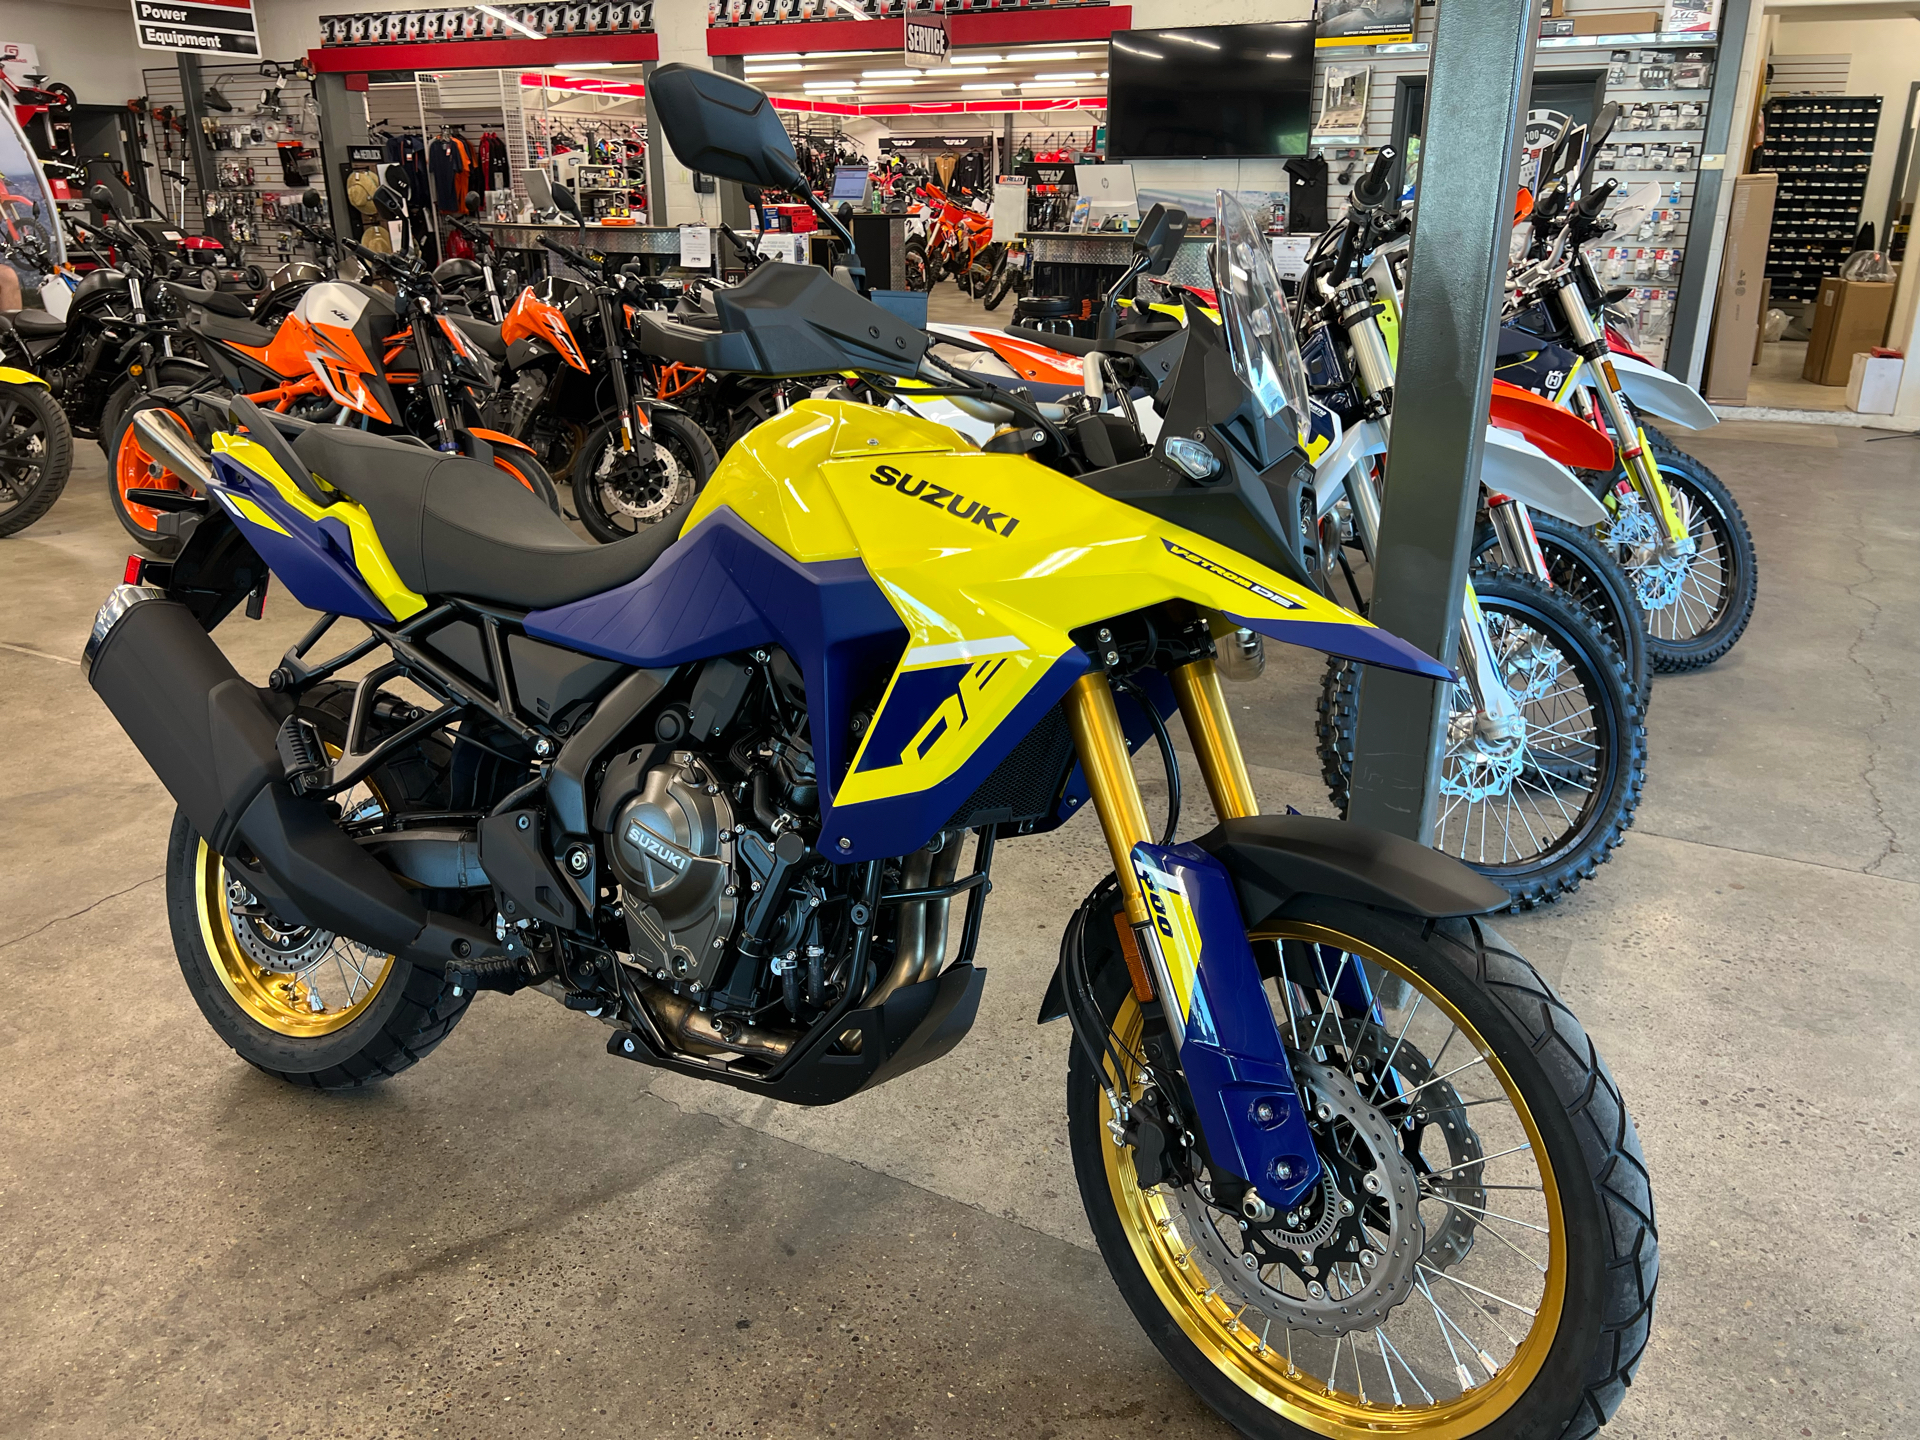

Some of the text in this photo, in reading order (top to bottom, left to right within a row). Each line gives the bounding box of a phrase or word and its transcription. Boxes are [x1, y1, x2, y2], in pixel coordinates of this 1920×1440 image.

[141, 4, 187, 21] Power
[145, 28, 222, 48] Equipment
[907, 23, 945, 55] SERVICE
[1685, 52, 1704, 60] XTC
[1526, 130, 1540, 141] 100
[1037, 170, 1065, 182] FLY
[330, 309, 350, 321] KTM
[870, 465, 1020, 538] SUZUKI
[1250, 585, 1294, 608] DE
[628, 828, 686, 870] SUZUKI
[1139, 869, 1174, 939] 800
